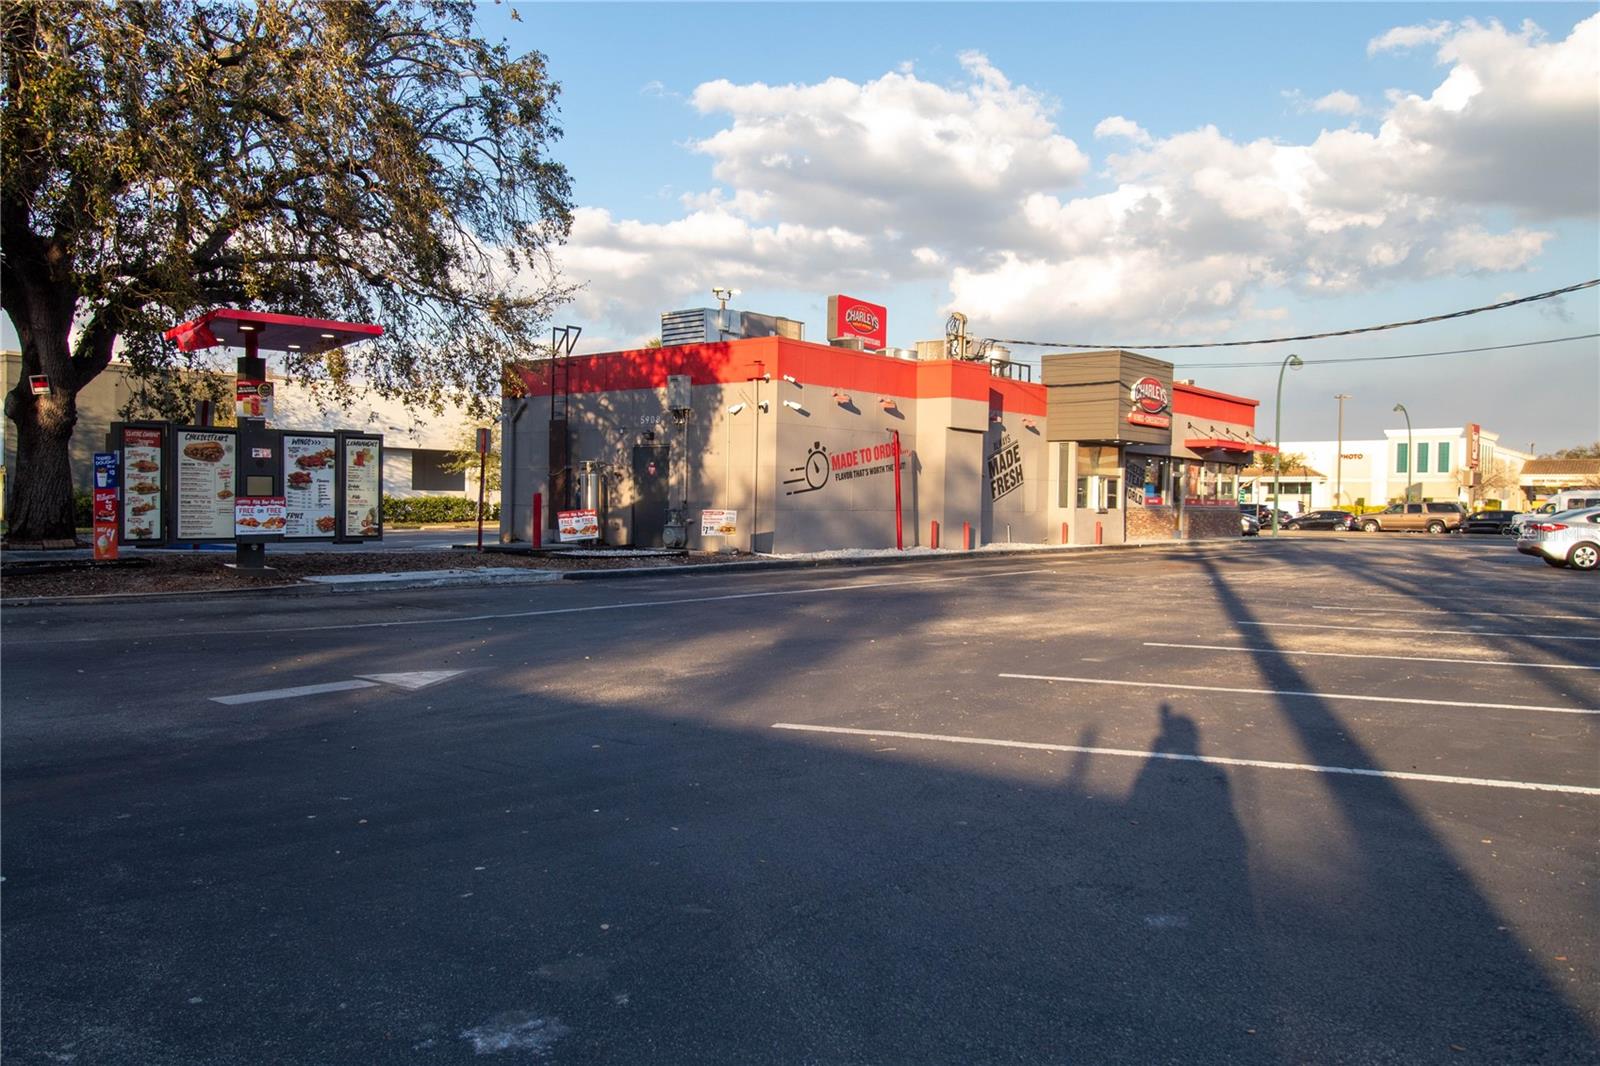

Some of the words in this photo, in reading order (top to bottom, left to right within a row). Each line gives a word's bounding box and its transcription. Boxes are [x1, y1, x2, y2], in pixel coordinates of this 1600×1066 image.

[846, 309, 879, 330] CHARLEYS
[1135, 383, 1168, 405] CHARLEYS
[831, 453, 859, 471] MADE
[860, 447, 871, 464] TO
[873, 441, 902, 461] ORDE
[988, 444, 1021, 479] MADE
[835, 471, 853, 481] FLAVOR
[853, 467, 869, 479] THAT'S
[870, 466, 885, 475] WORTH
[991, 464, 1024, 500] FRESH
